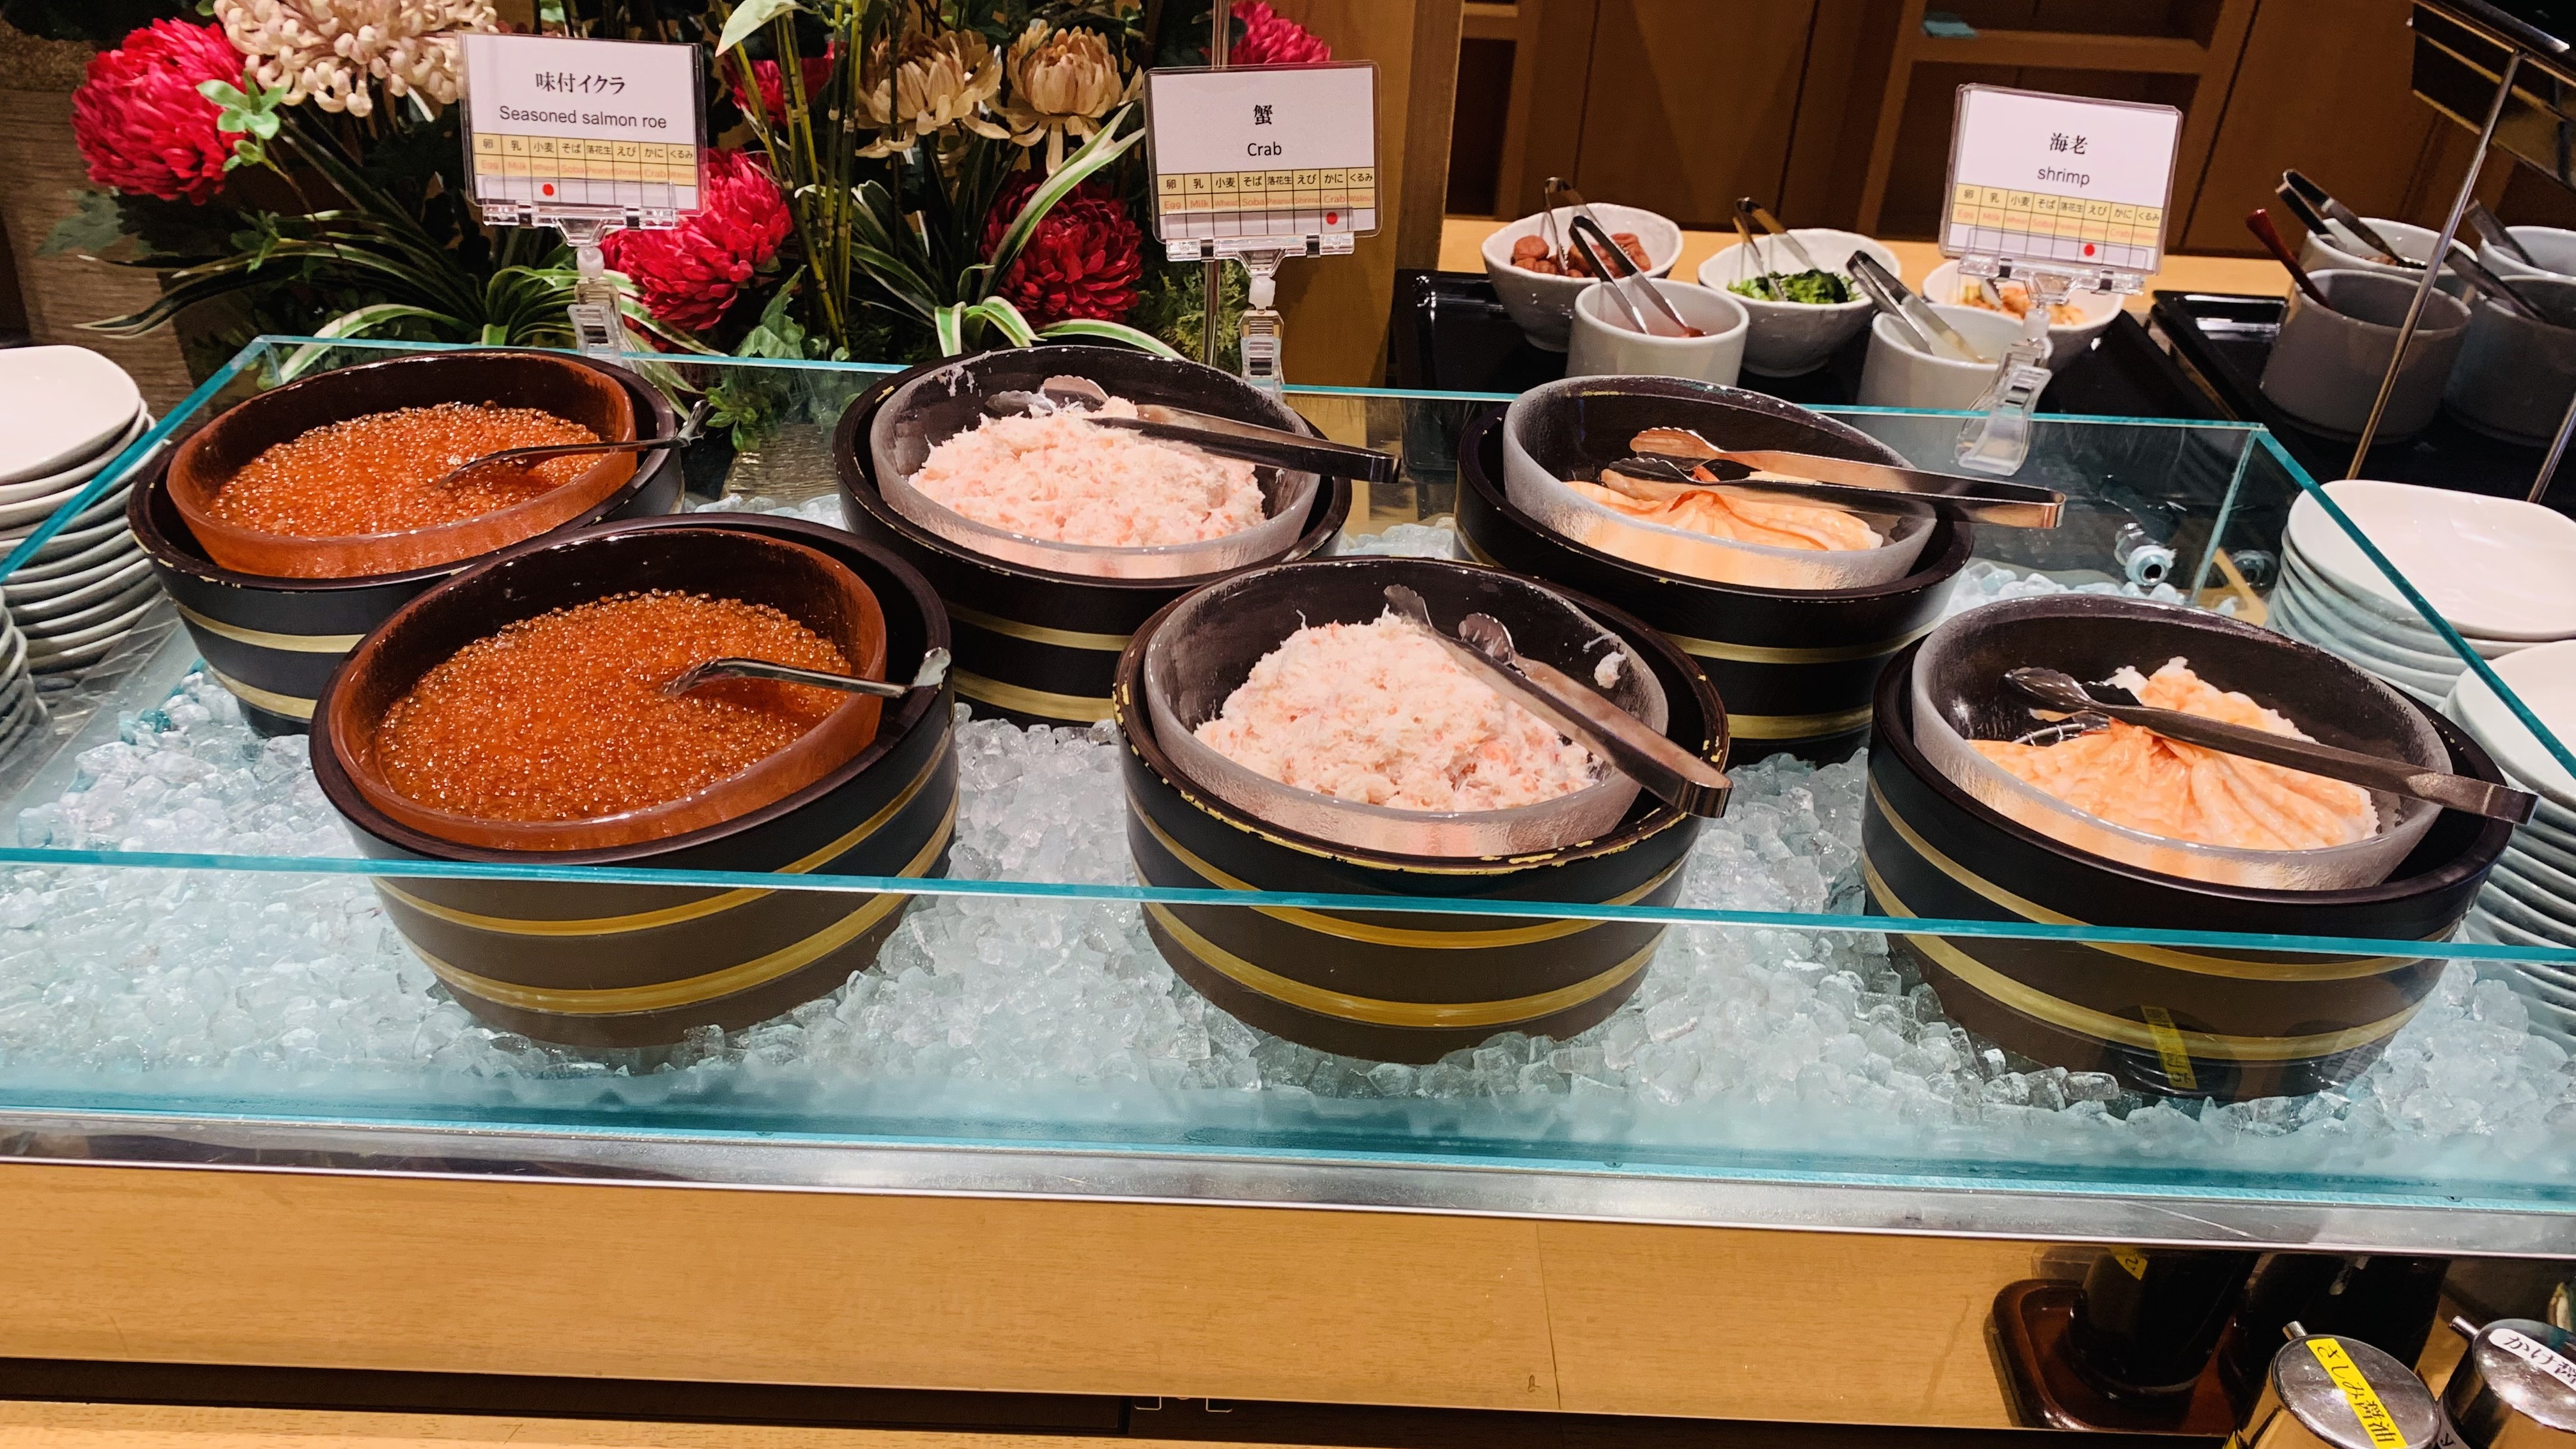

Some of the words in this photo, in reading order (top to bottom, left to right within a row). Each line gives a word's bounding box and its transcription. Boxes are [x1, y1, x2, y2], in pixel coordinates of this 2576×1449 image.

[535, 71, 626, 95] 味付イクラ
[499, 105, 577, 124] Seasoned
[582, 111, 637, 127] salmon
[642, 116, 667, 129] roe
[1253, 104, 1273, 126] 蟹
[511, 140, 522, 151] 乳
[533, 141, 555, 153] 小麦
[562, 142, 582, 154] そば
[586, 144, 612, 155] 落花生
[617, 146, 636, 157] えび
[644, 148, 664, 158] かに
[670, 150, 693, 160] くるみ
[1247, 141, 1282, 157] Crab
[2049, 132, 2088, 155] 海老
[562, 164, 585, 174] Soba
[644, 169, 666, 178] Crab
[1166, 179, 1176, 190] 卵
[1193, 178, 1204, 189] 乳
[1215, 177, 1236, 188] 小麦
[1243, 176, 1263, 187] そば
[1267, 176, 1292, 186] 落花生
[1297, 174, 1317, 185] えび
[1324, 174, 1344, 184] かに
[1349, 173, 1374, 183] くるみ
[2037, 166, 2090, 187] shrimp
[1164, 201, 1181, 210] Egg
[1190, 200, 1209, 209] Milk
[1215, 199, 1238, 207] Wheat
[1241, 197, 1266, 207] Soba
[1323, 194, 1346, 204] Crab
[1990, 192, 2000, 203] 乳
[2011, 195, 2030, 207] 小麦
[2037, 199, 2057, 210] そば
[2087, 205, 2108, 216] えび
[2113, 208, 2133, 219] かに
[2138, 211, 2160, 222] くるみ
[2317, 1345, 2397, 1443] さしみ醤油
